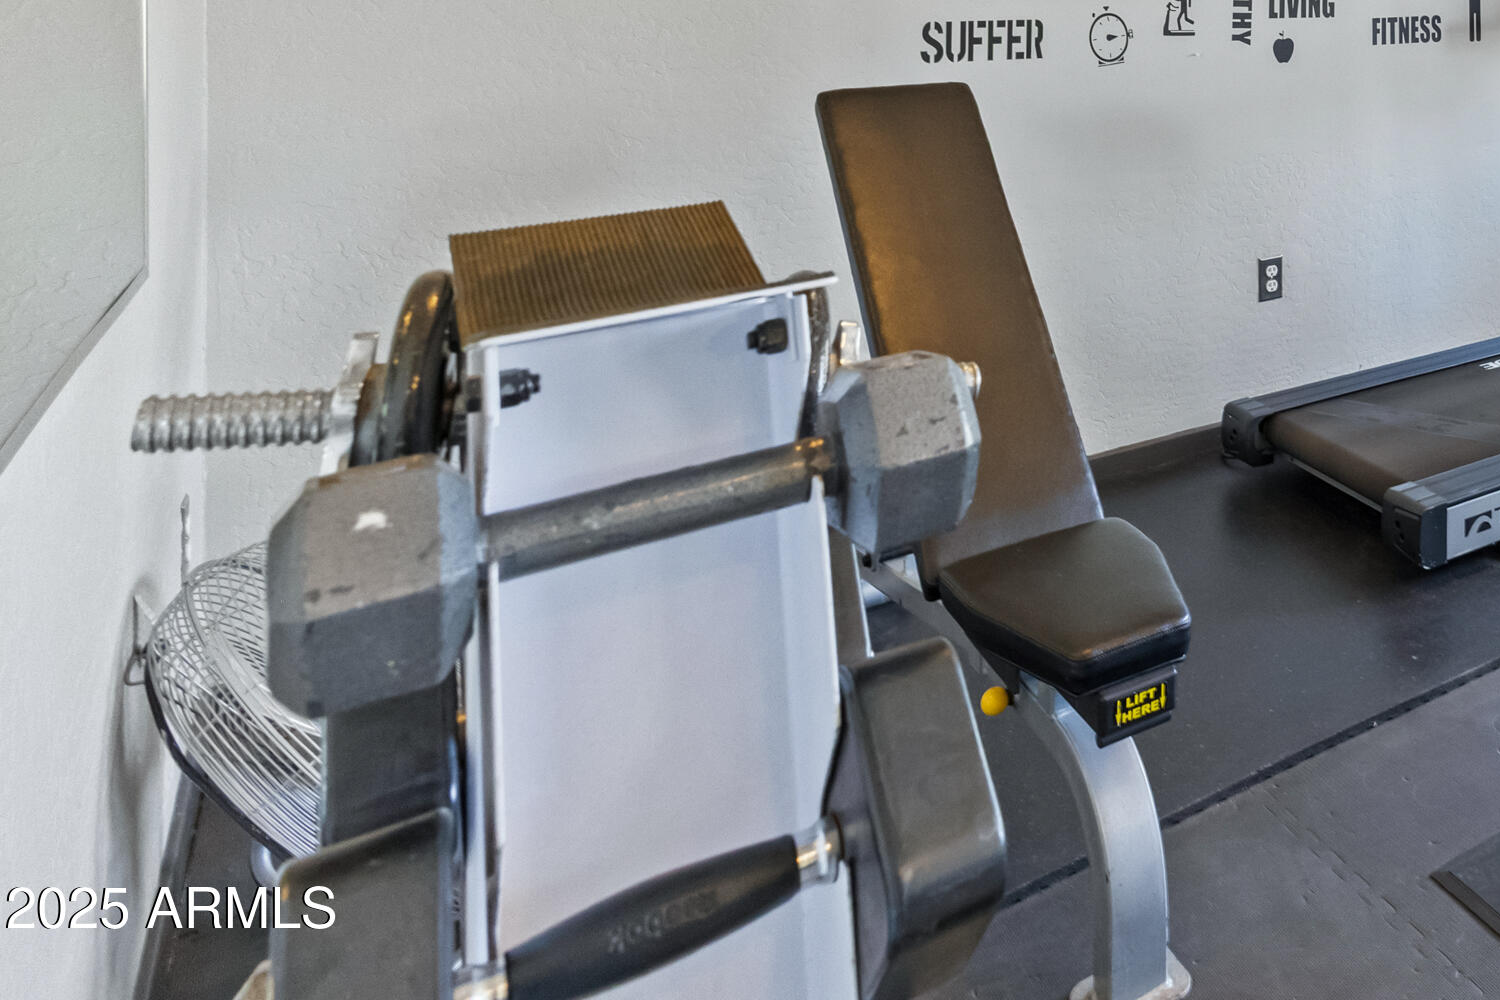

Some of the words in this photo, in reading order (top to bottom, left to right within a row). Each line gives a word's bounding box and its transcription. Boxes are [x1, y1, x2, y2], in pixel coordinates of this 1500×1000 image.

[920, 19, 1043, 63] SUFFER
[1372, 15, 1441, 45] FITNESS
[1126, 687, 1156, 708] LIFT
[1121, 699, 1160, 724] HERE
